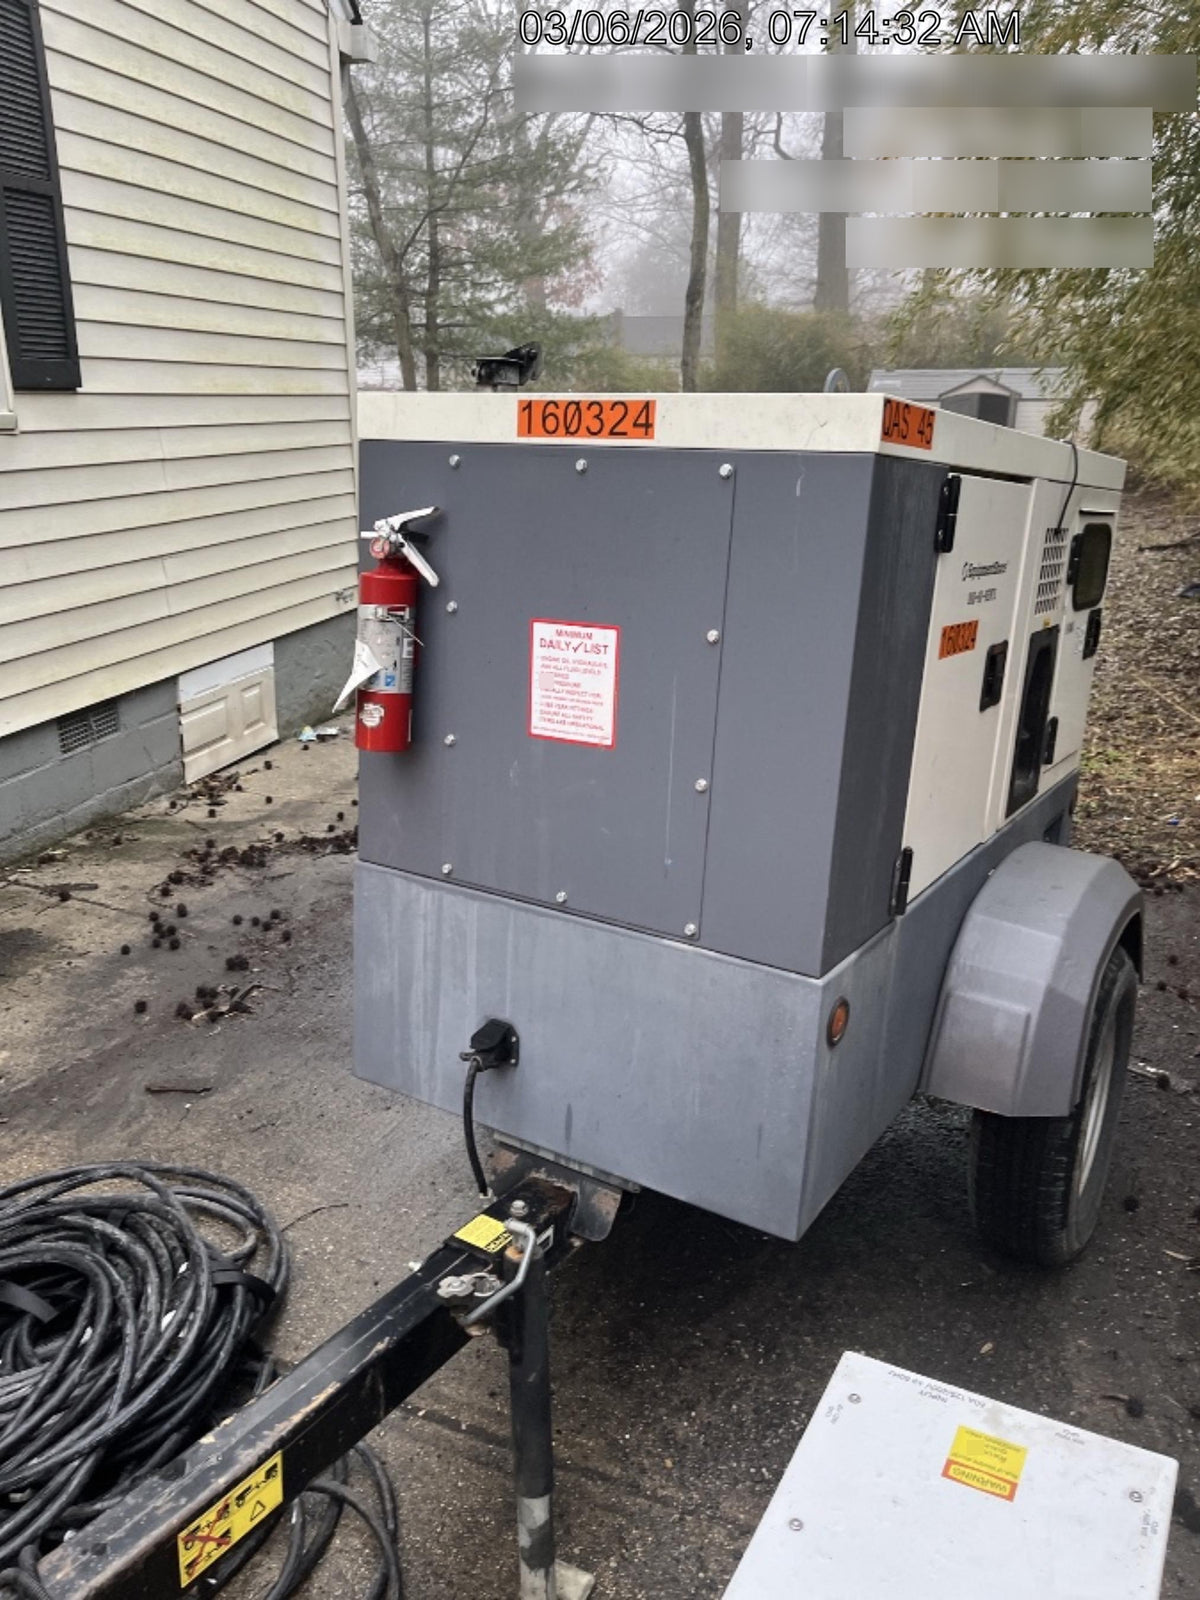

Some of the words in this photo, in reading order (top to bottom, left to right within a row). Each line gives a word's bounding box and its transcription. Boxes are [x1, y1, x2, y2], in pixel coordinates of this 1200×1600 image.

[521, 400, 653, 436] 160324
[917, 408, 935, 444] 45
[540, 638, 571, 651] DAILY
[584, 643, 609, 655] LIST
[555, 629, 593, 640] MINIMUM
[951, 1466, 1008, 1493] WARNING
